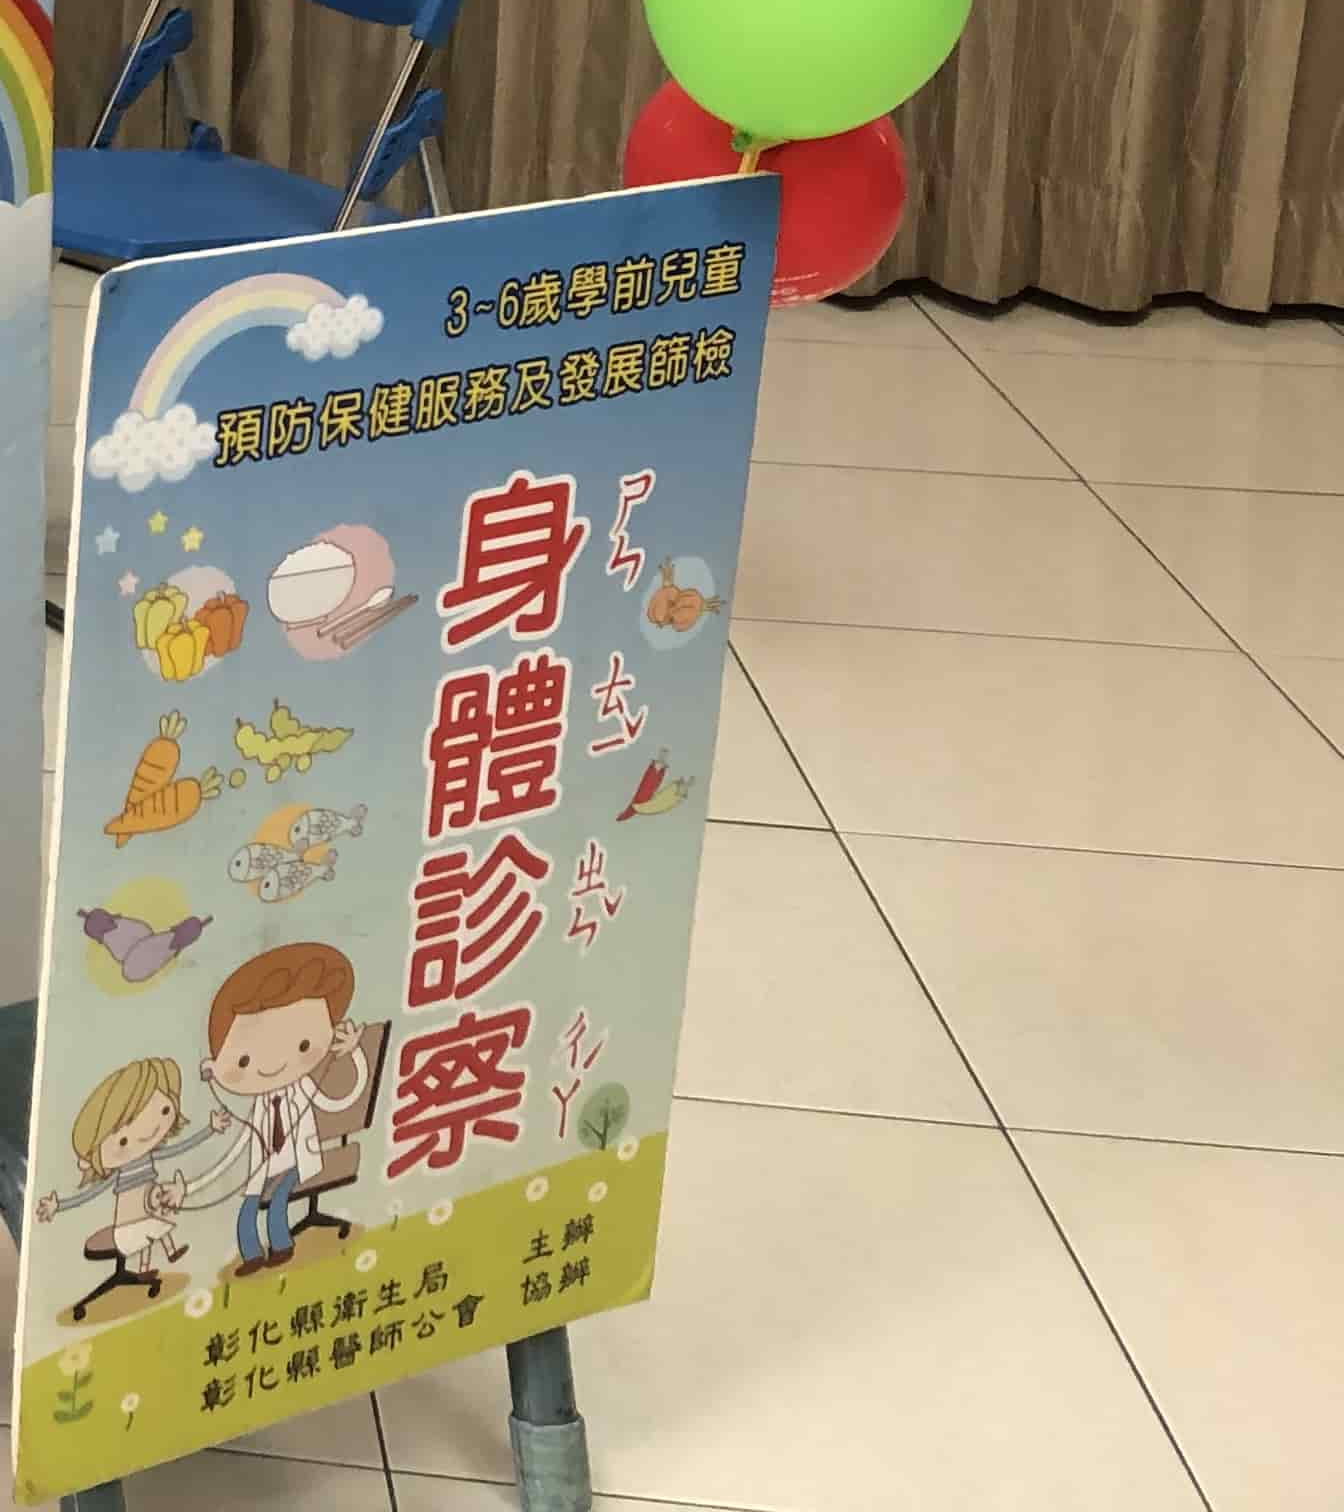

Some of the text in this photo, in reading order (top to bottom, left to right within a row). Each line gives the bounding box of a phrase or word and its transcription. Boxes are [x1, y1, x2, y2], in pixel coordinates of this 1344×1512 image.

[444, 242, 745, 337] 3~6歲學前兒童
[214, 326, 738, 468] 預防保健服務及發展篩檢
[384, 472, 588, 1181] 身體診察
[200, 1255, 592, 1412] 彰化縣醫師公會 協辦
[203, 1213, 595, 1368] 彰化縣衛生局 主辦
